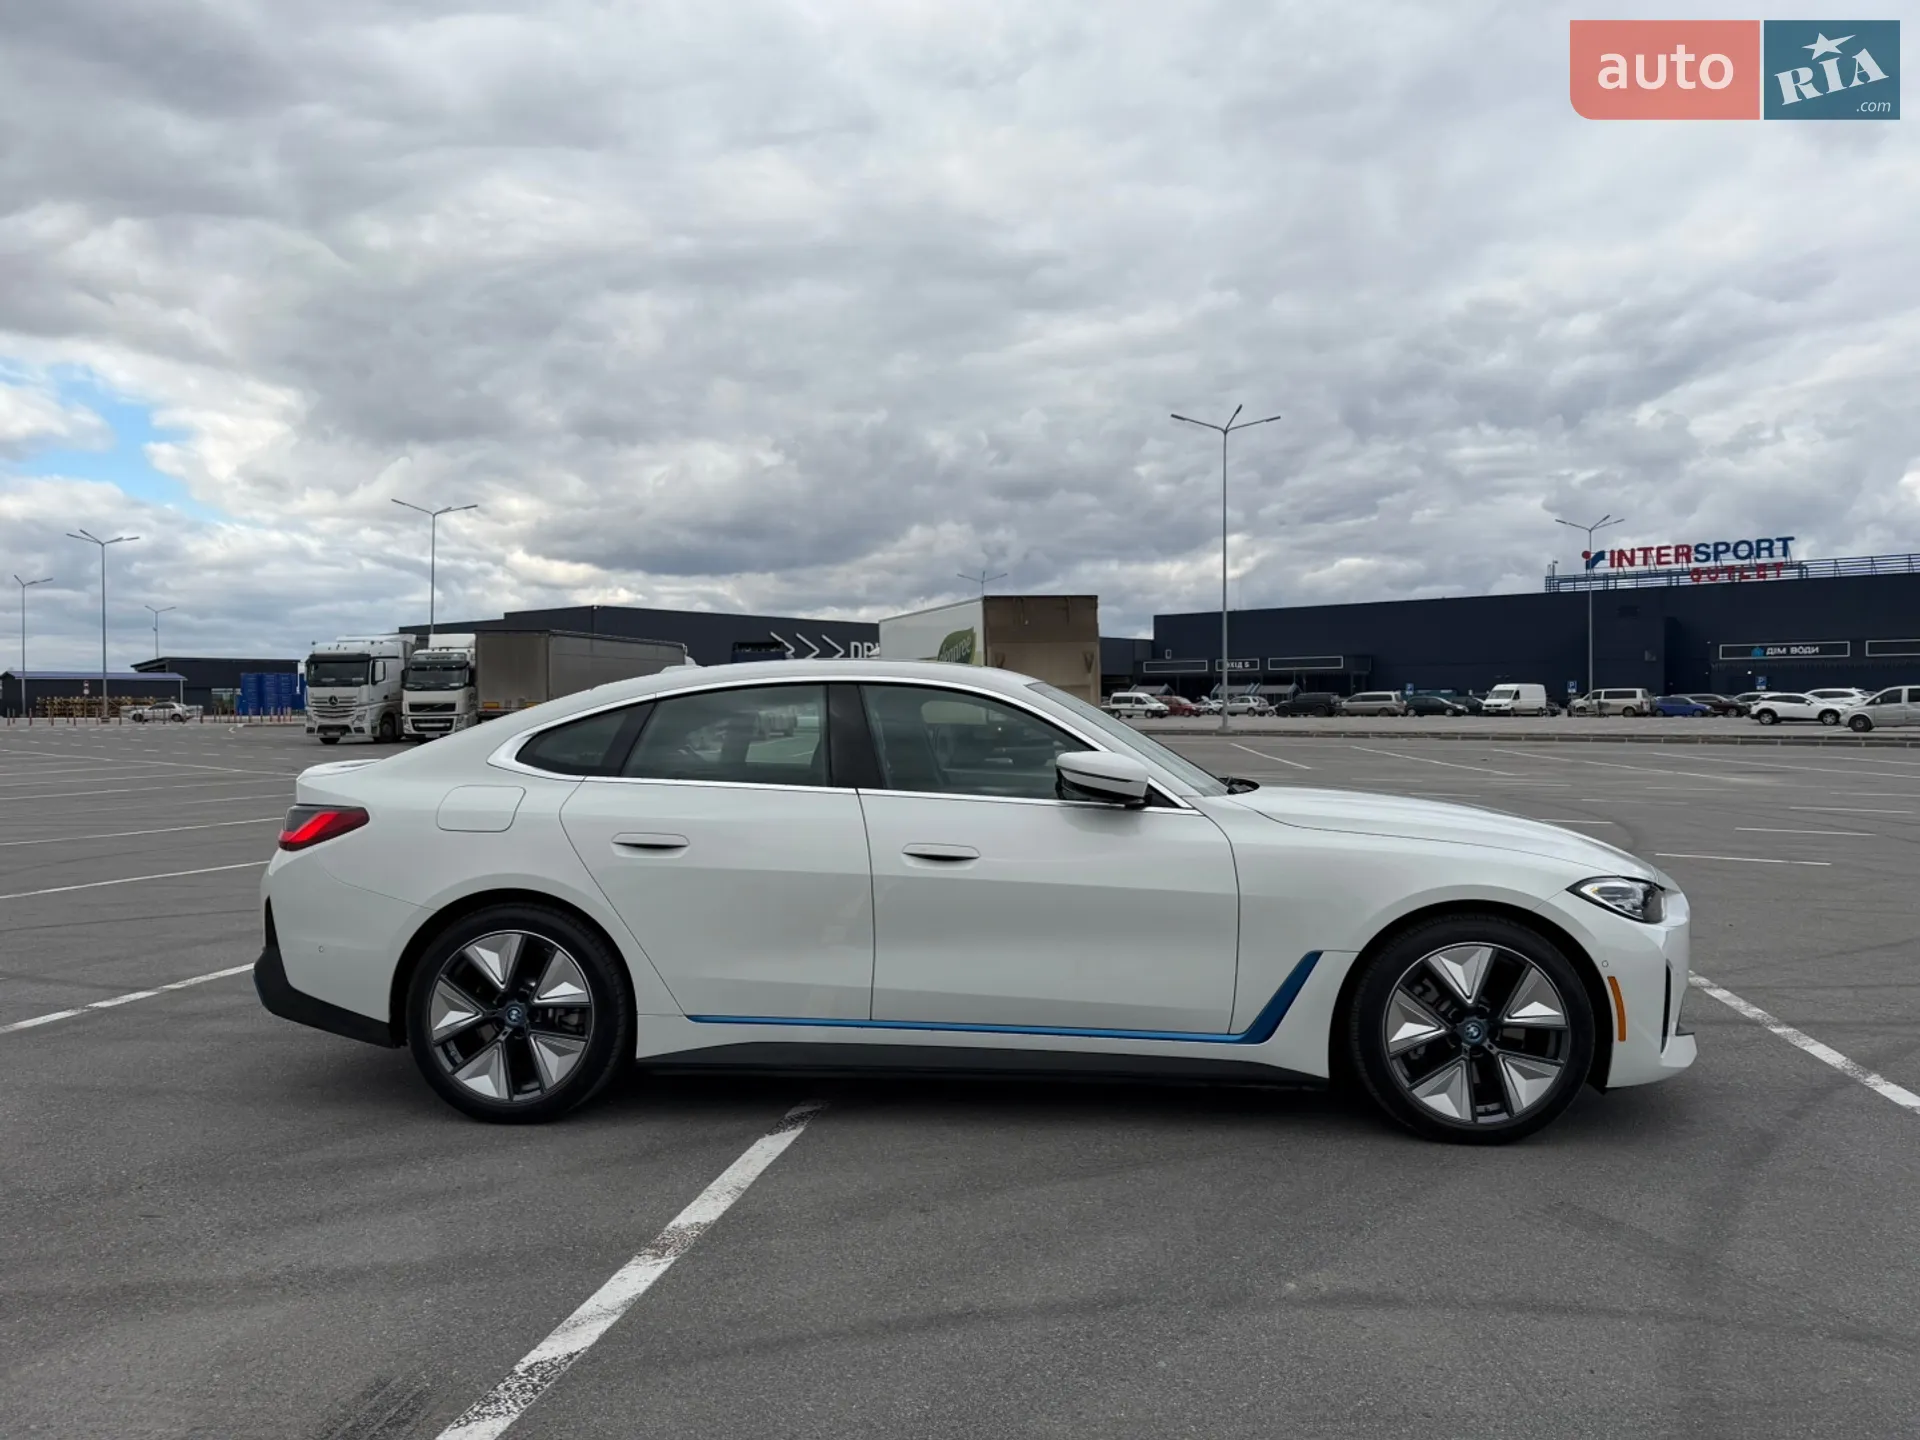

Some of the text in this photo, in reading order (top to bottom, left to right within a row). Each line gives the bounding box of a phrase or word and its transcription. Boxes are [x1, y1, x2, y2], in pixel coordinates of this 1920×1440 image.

[1609, 536, 1795, 568] INTERSPORT
[1690, 562, 1784, 583] OUTLET
[1766, 646, 1820, 655] ДІМ ВОДИ
